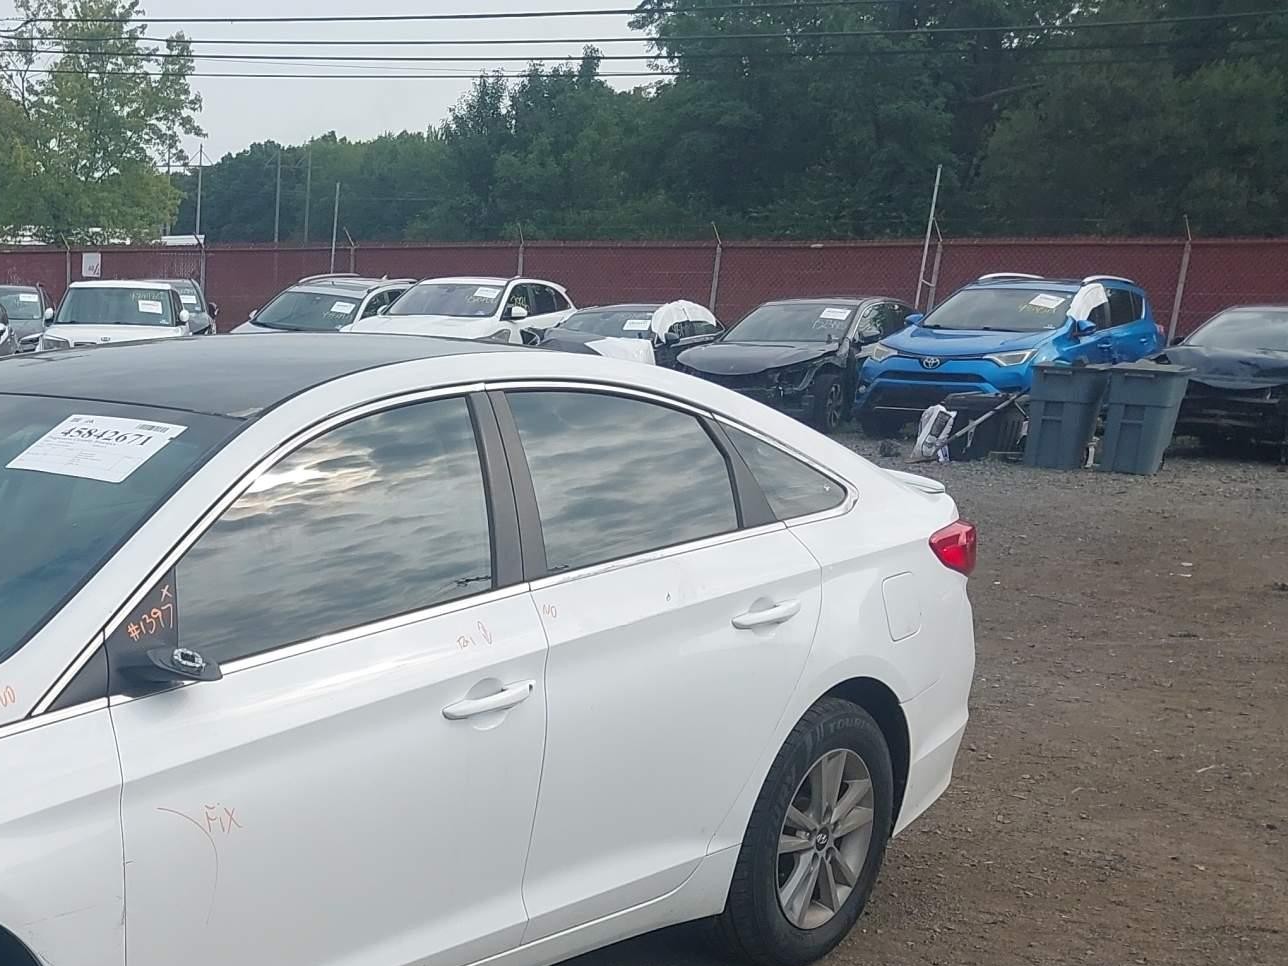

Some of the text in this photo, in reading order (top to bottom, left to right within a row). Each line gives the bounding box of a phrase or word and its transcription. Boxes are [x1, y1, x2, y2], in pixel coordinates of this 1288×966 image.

[61, 426, 153, 447] 45842671
[127, 603, 173, 642] #1397
[204, 802, 244, 833] FIX
